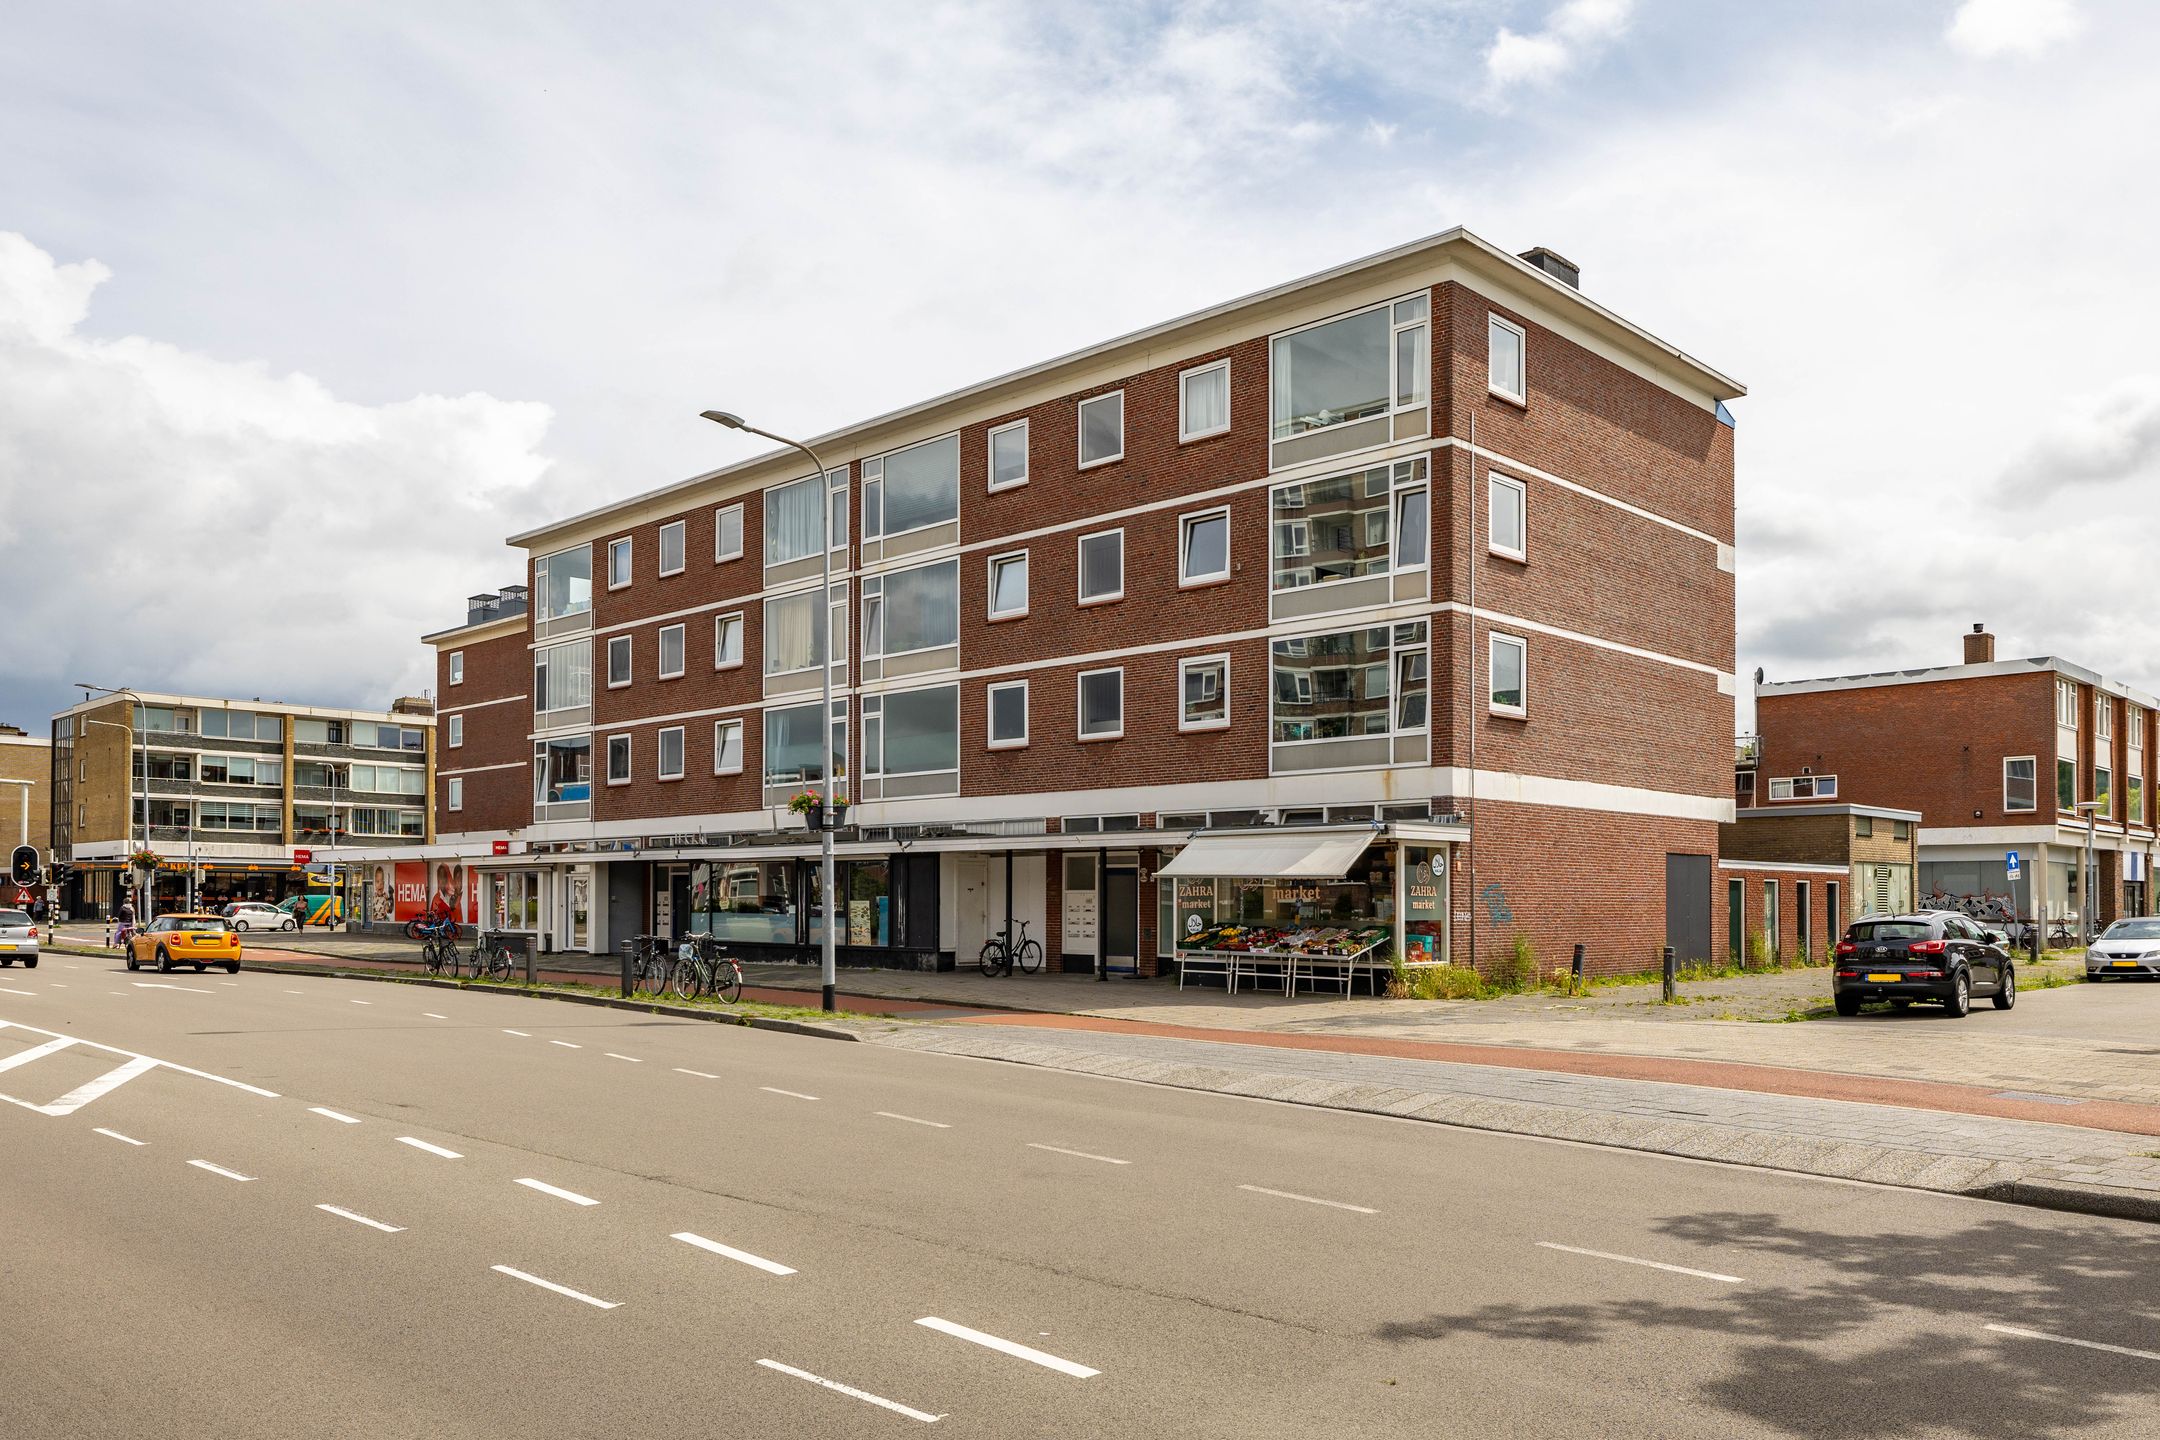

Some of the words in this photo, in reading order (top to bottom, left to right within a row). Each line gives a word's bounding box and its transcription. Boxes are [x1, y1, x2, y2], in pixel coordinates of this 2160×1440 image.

[398, 883, 427, 902] HEMA
[1179, 886, 1213, 896] ZAHRA
[1272, 885, 1321, 899] market
[1410, 885, 1437, 896] ZAHRA
[1182, 899, 1211, 909] market
[1412, 899, 1435, 909] market
